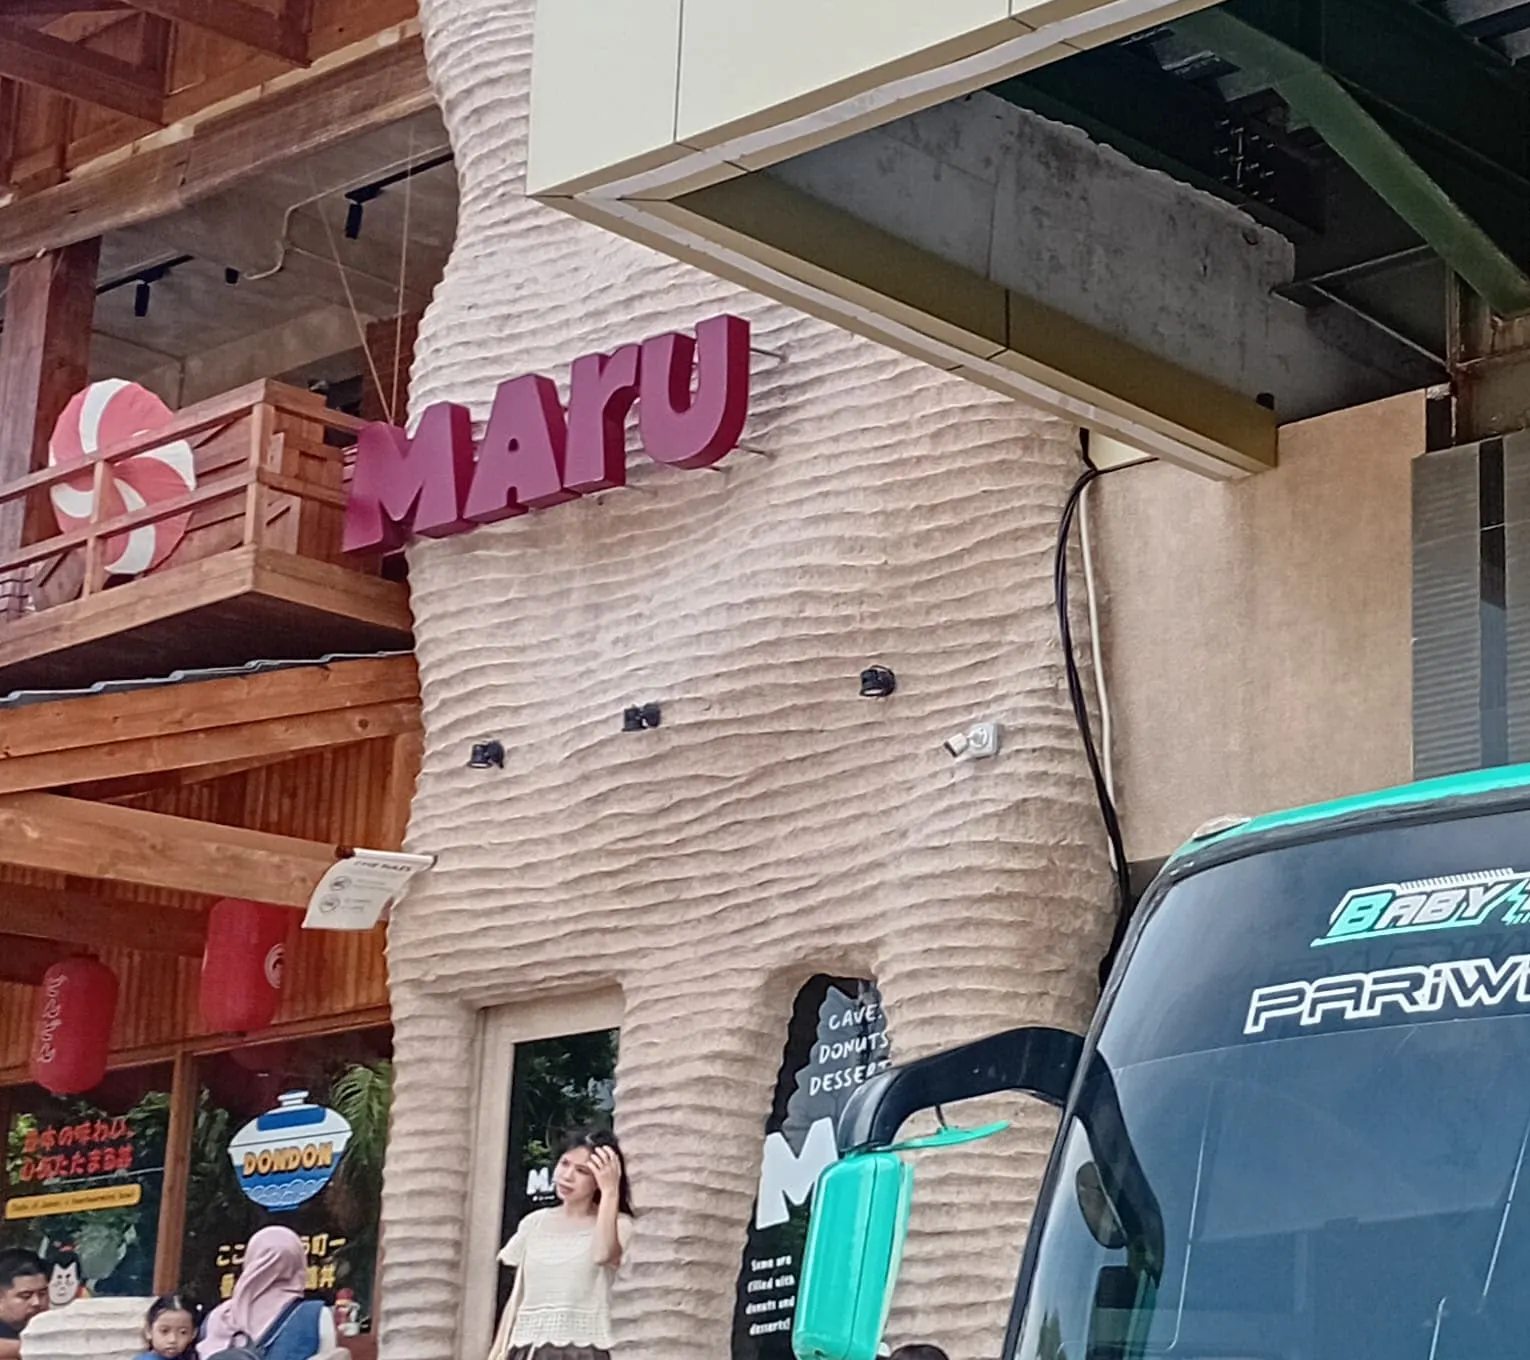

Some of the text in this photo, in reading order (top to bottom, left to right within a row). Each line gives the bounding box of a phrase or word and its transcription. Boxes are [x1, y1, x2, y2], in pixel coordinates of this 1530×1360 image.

[1326, 879, 1508, 939] BABY
[818, 1027, 889, 1065] DONUTS
[242, 1142, 334, 1178] DONDON
[751, 1255, 792, 1272] Some are
[747, 1274, 795, 1293] filled with
[745, 1300, 776, 1315] donuts
